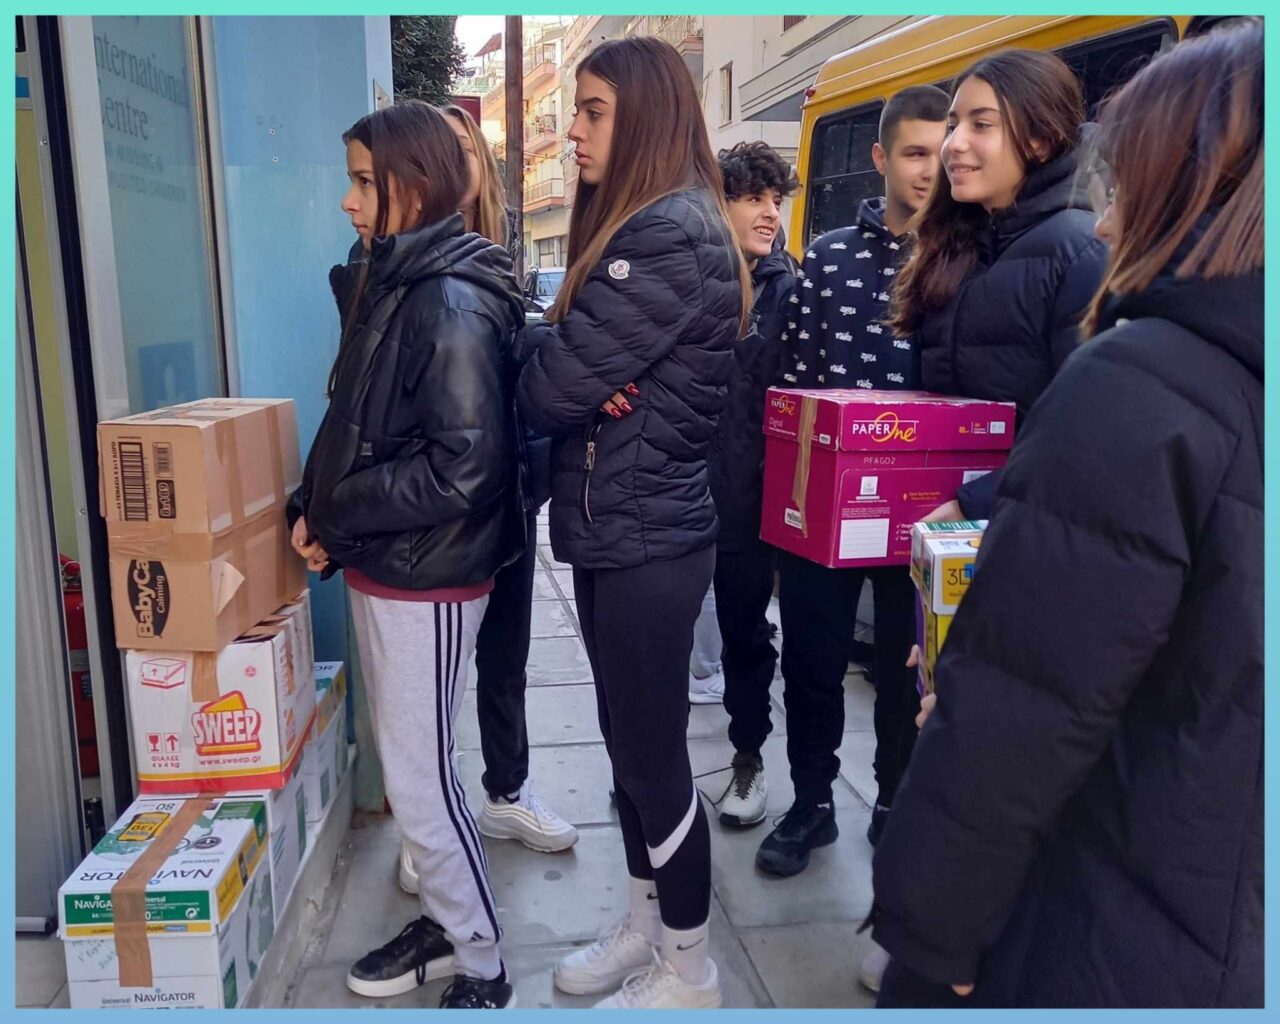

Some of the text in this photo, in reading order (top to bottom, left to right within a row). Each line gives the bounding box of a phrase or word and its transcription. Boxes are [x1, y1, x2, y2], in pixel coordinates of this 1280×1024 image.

[93, 32, 189, 108] nternational
[100, 93, 149, 140] entre
[852, 423, 890, 435] PAPER
[133, 560, 154, 638] BabyCa
[157, 576, 165, 613] Calming
[192, 708, 258, 744] SWEEP
[200, 757, 261, 766] www.sweep.gr
[74, 900, 113, 909] NAVIGA
[134, 993, 195, 1003] NAVIGATOR
